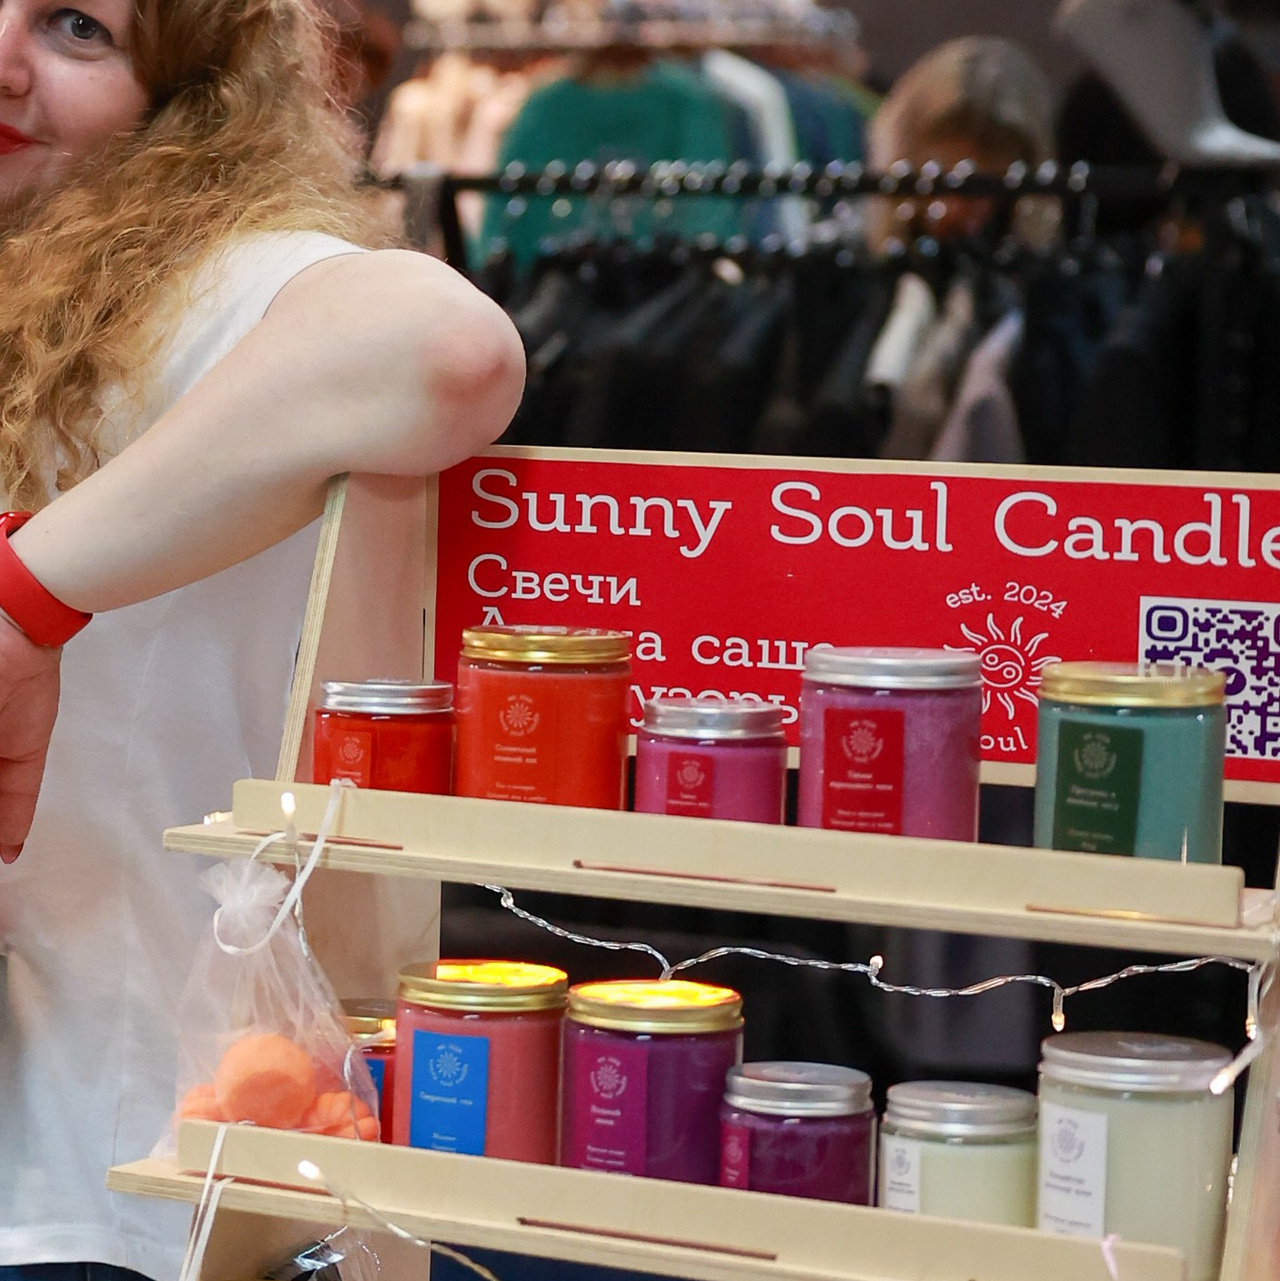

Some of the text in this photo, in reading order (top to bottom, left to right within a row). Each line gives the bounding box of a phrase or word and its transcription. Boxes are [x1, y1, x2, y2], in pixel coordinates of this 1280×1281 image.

[472, 469, 732, 558] Sunny
[771, 481, 953, 552] Soul
[468, 554, 641, 606] Свечи
[946, 581, 1068, 619] est. 2024
[691, 634, 834, 671] саш
[980, 726, 1028, 752] oul
